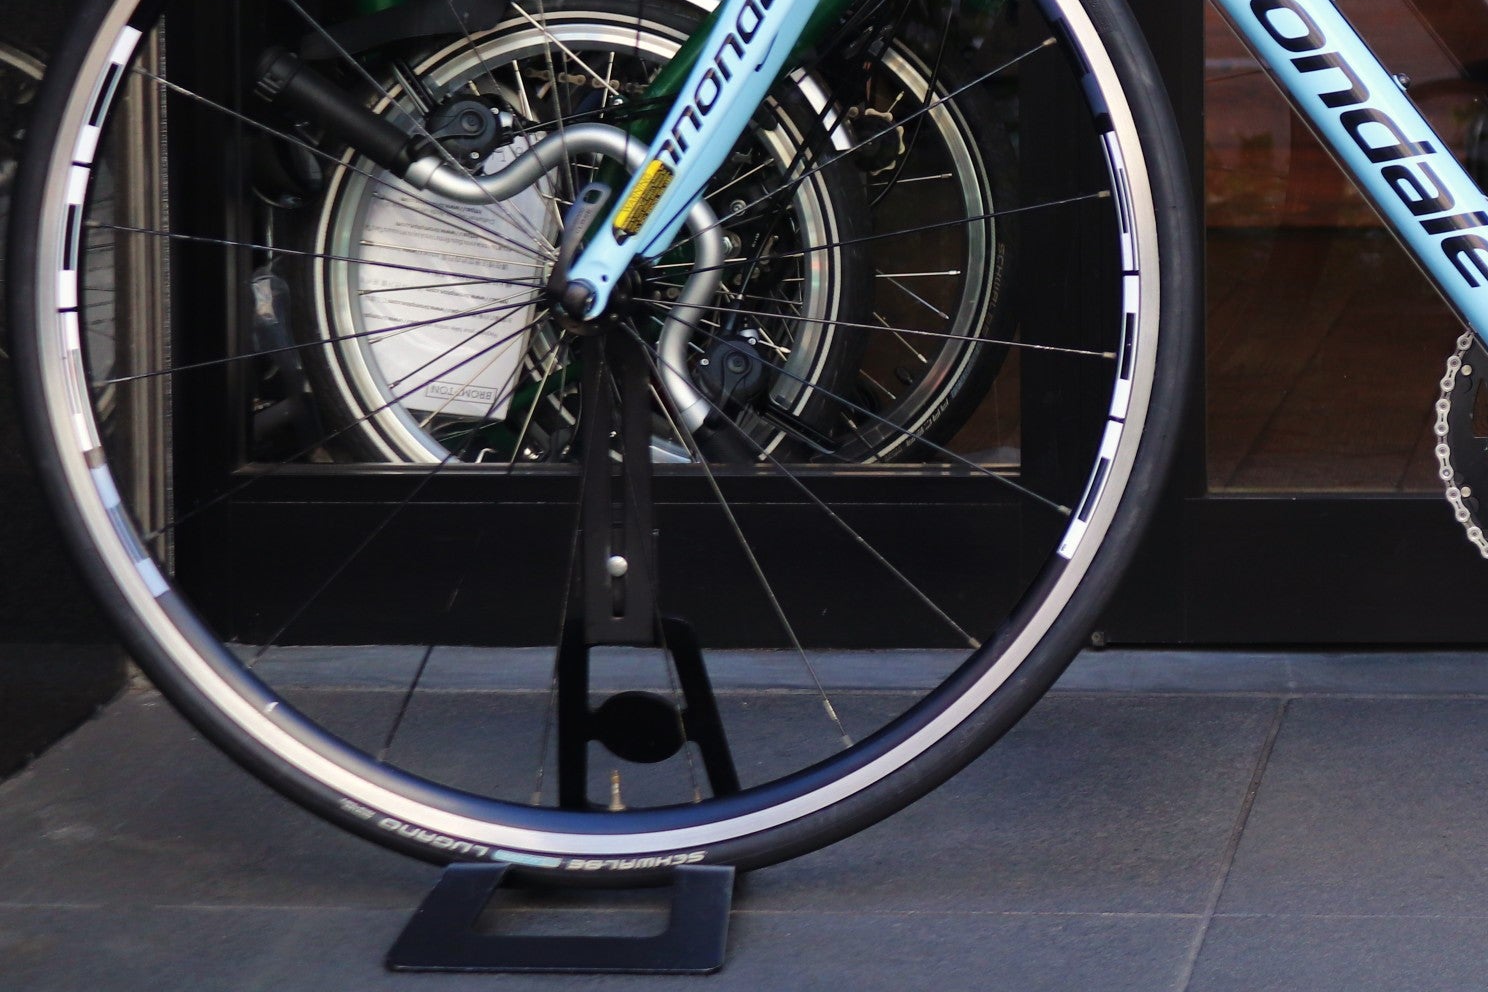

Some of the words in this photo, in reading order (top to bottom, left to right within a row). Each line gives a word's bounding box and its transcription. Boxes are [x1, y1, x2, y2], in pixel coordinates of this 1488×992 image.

[430, 383, 492, 400] BROMTON
[377, 818, 490, 858] LUGANO
[566, 850, 706, 872] SCHWALBE
